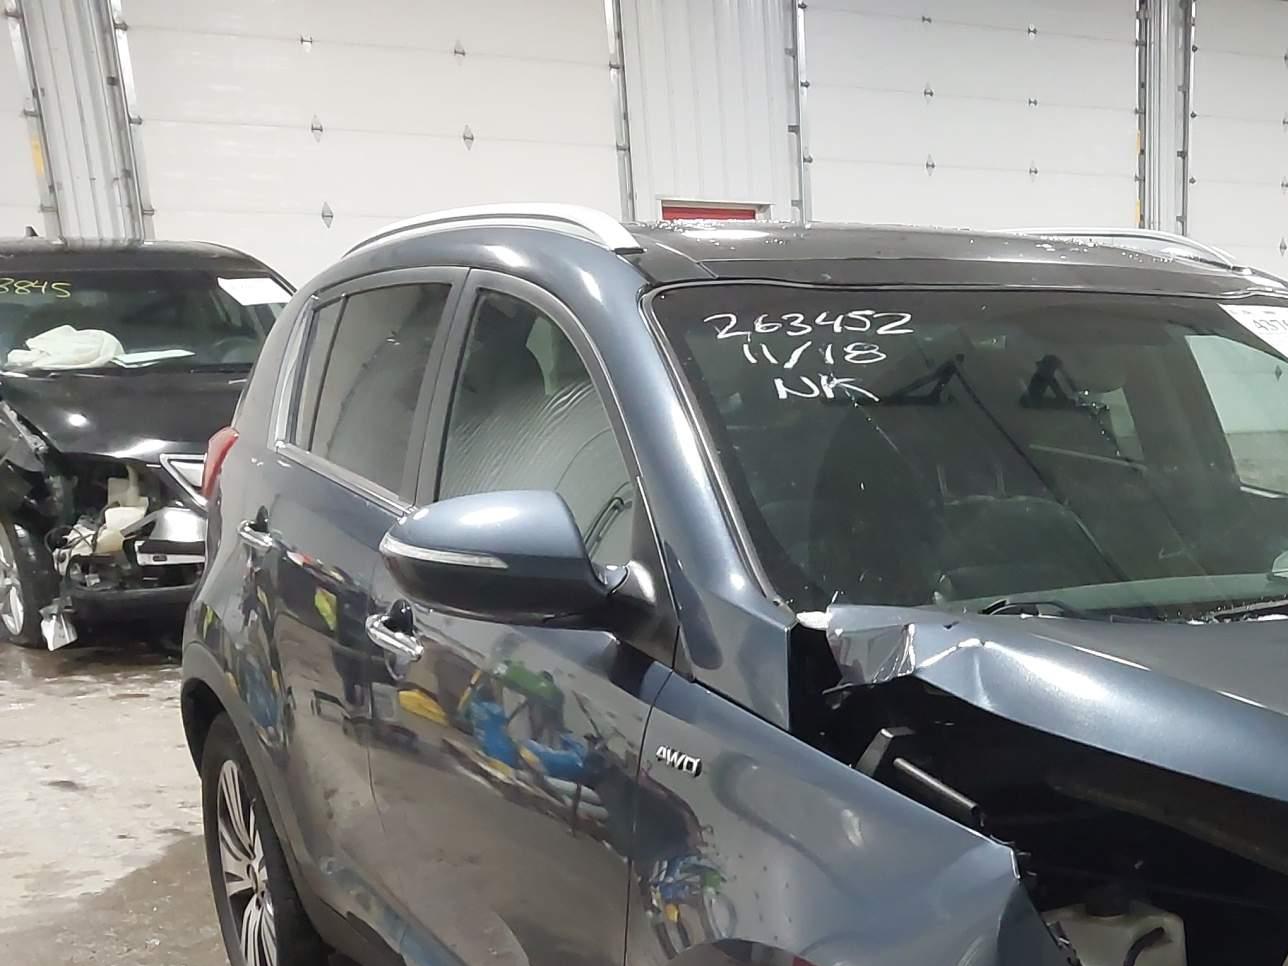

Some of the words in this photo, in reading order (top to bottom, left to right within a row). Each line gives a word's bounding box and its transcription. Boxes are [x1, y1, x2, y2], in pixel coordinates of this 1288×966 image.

[703, 310, 914, 341] 263452
[742, 340, 887, 369] 11/18
[773, 372, 881, 403] NK
